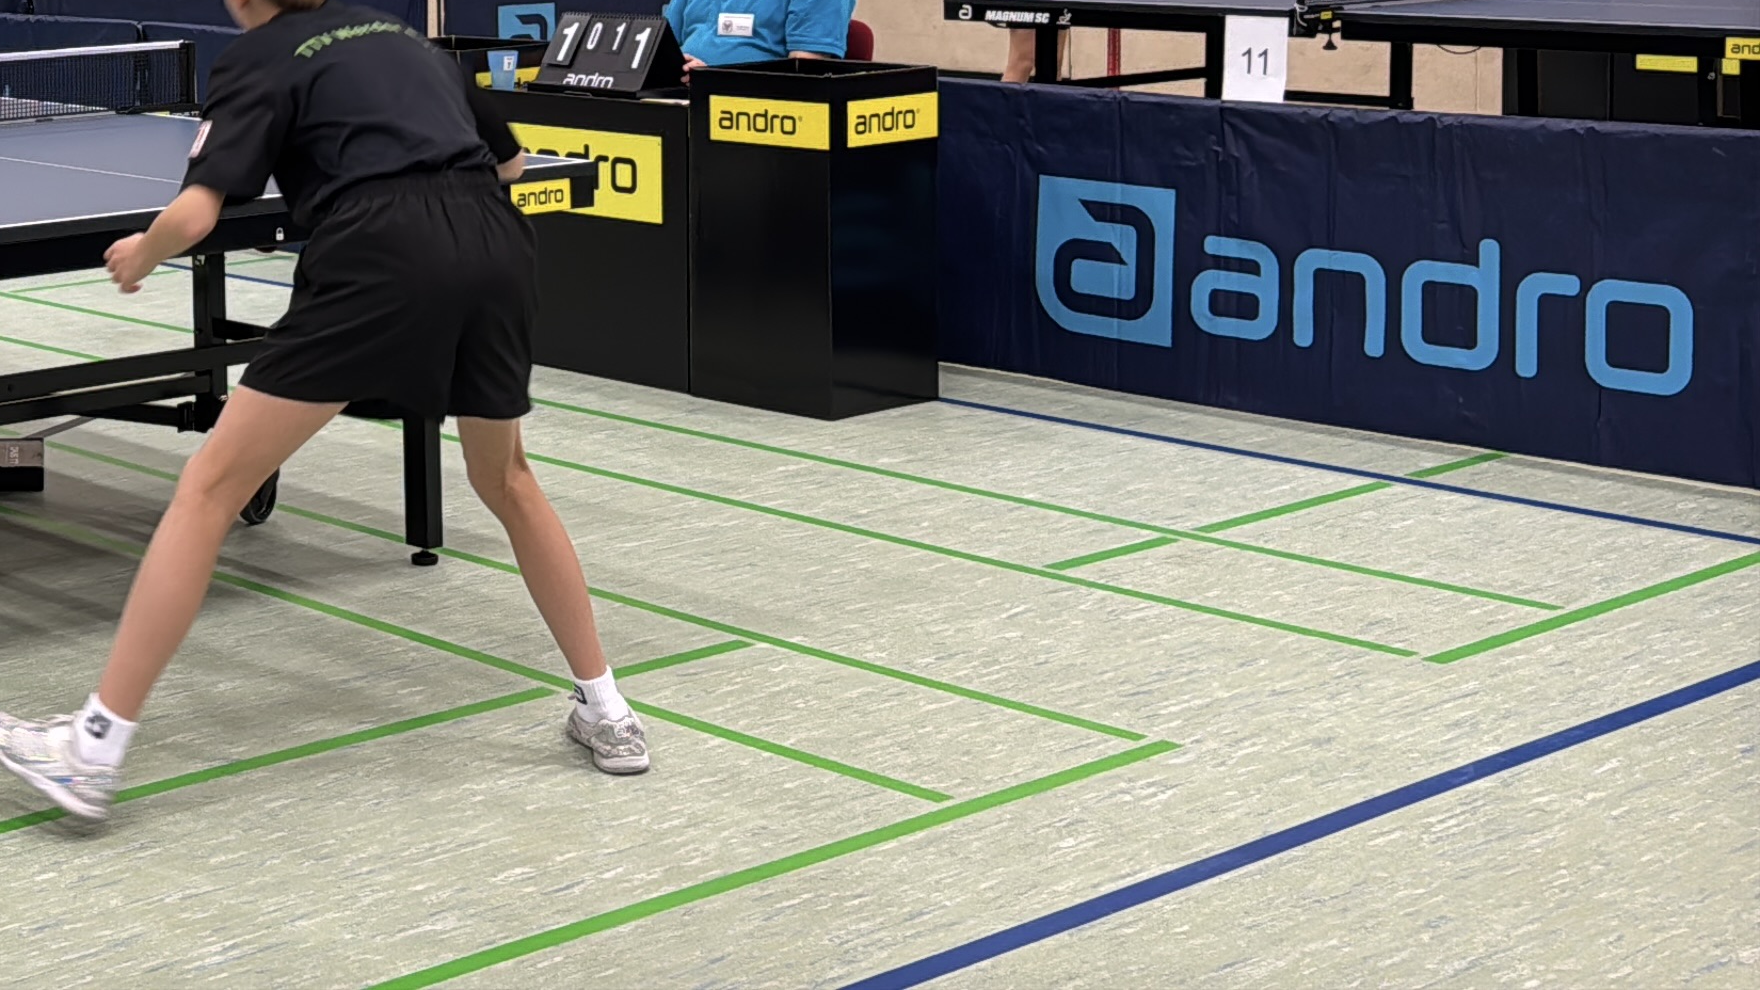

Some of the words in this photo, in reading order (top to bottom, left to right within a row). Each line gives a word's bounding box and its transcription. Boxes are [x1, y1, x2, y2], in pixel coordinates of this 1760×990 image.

[984, 9, 1035, 23] MAGNUM
[1034, 11, 1051, 24] SC
[556, 22, 580, 61] 1
[586, 22, 603, 50] 0
[612, 22, 627, 51] 1
[631, 27, 652, 69] 1
[1241, 47, 1269, 76] 11
[718, 109, 797, 136] andro
[854, 107, 916, 135] andro
[517, 187, 564, 208] andro
[1190, 237, 1694, 397] andro
